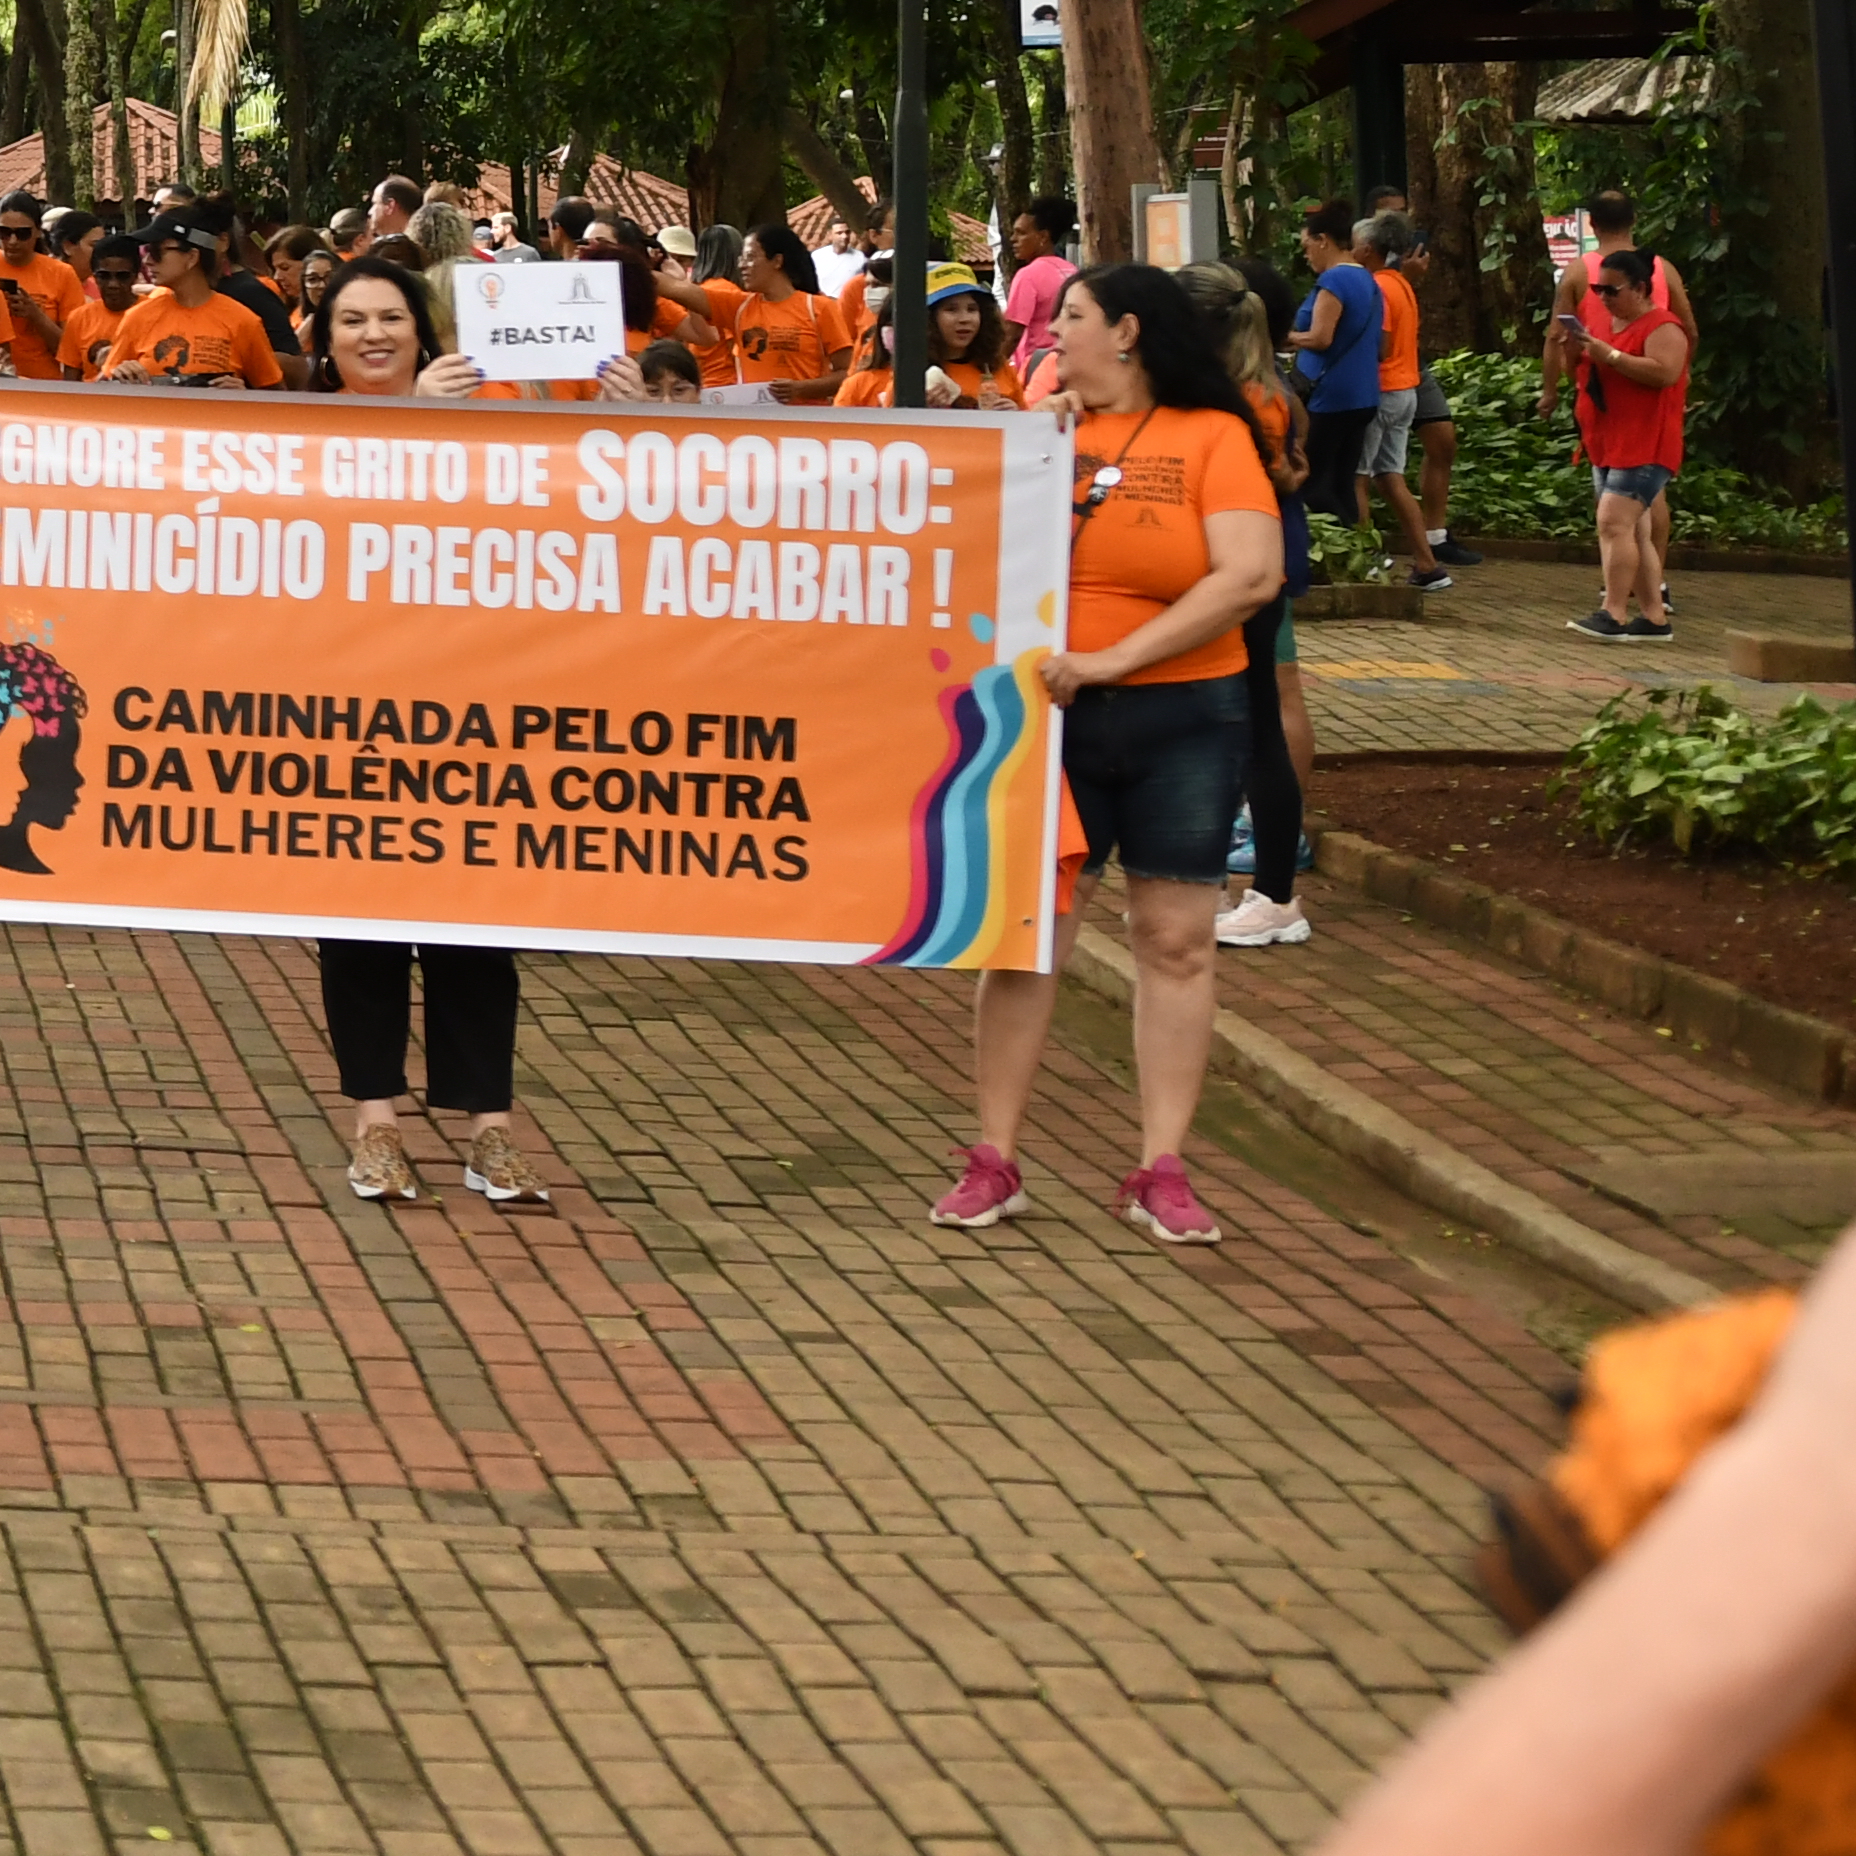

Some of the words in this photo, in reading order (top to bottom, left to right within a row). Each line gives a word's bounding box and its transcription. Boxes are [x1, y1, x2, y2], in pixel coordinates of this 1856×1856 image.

[490, 325, 595, 345] #BASTA!
[180, 430, 304, 499] ESSE
[321, 436, 467, 503] GRITO
[488, 444, 549, 507] DE
[577, 428, 953, 534] SOCORRO:
[347, 522, 621, 614] PRECISA
[642, 535, 912, 627] ACABAR
[113, 686, 496, 748] CAMINHADA
[511, 704, 672, 757] PELO
[686, 713, 798, 764] FIM
[108, 744, 200, 792] DA
[208, 742, 538, 811] VIOLÊNCIA
[550, 766, 811, 823] CONTRA
[102, 804, 444, 864] MULHERES
[464, 820, 498, 866] E
[516, 826, 810, 882] MENINAS
